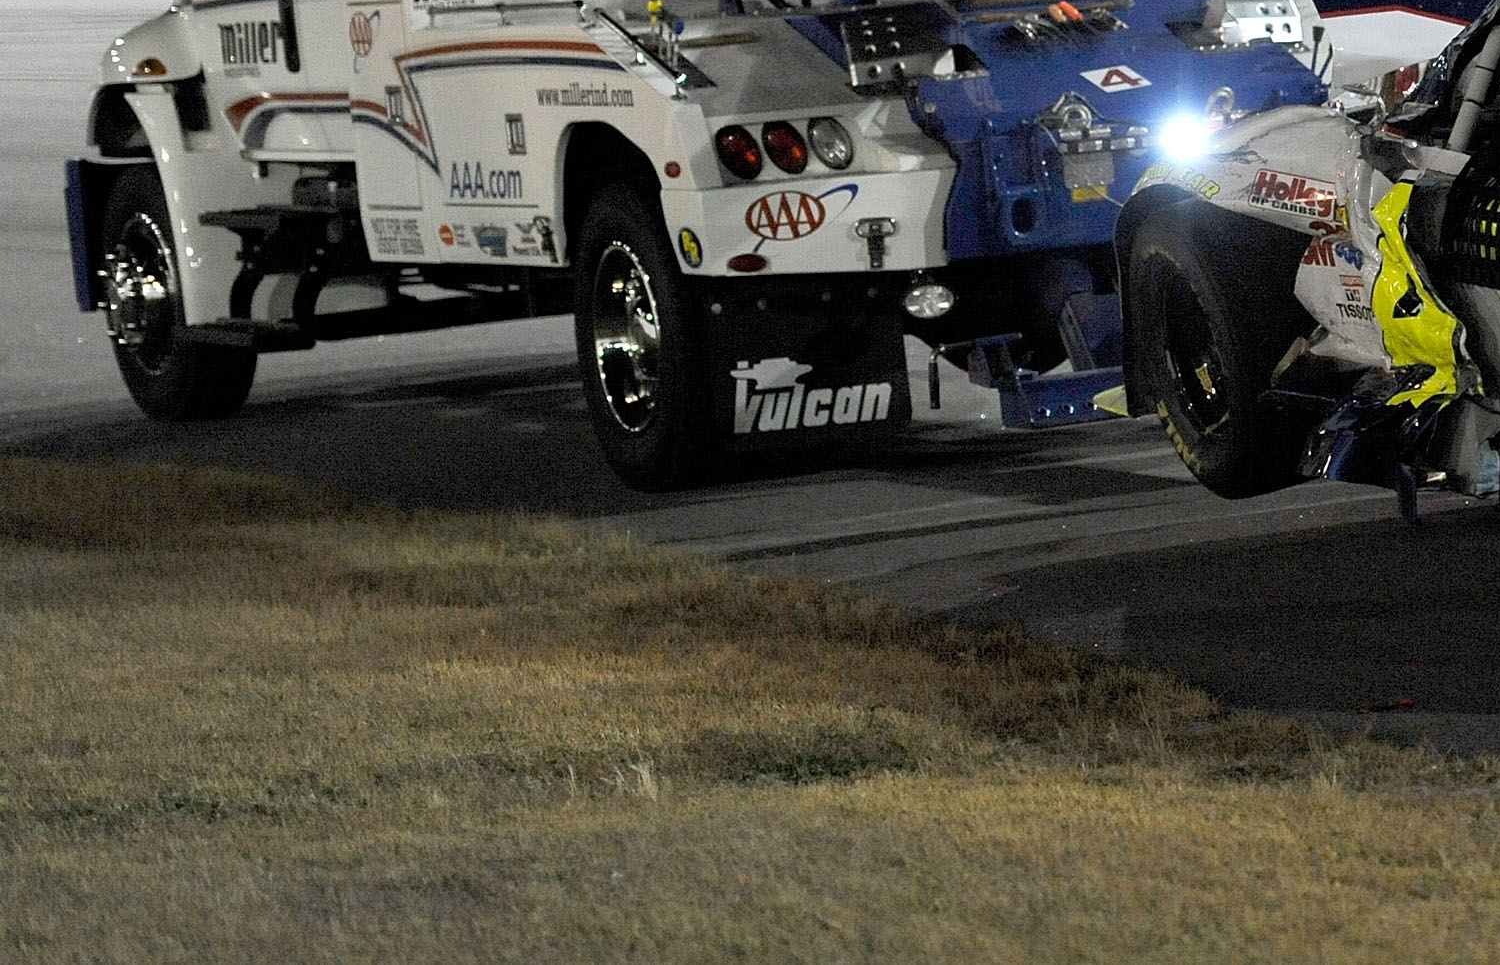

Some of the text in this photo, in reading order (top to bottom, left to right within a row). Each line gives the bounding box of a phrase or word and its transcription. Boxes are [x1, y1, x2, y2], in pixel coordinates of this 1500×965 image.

[536, 82, 635, 108] www.millerind.com
[1101, 68, 1142, 88] 4
[450, 162, 523, 199] AAA.com
[1255, 171, 1334, 217] Holley
[750, 192, 822, 241] AAA
[1336, 303, 1374, 321] TISSOT
[734, 375, 892, 434] Vulcan
